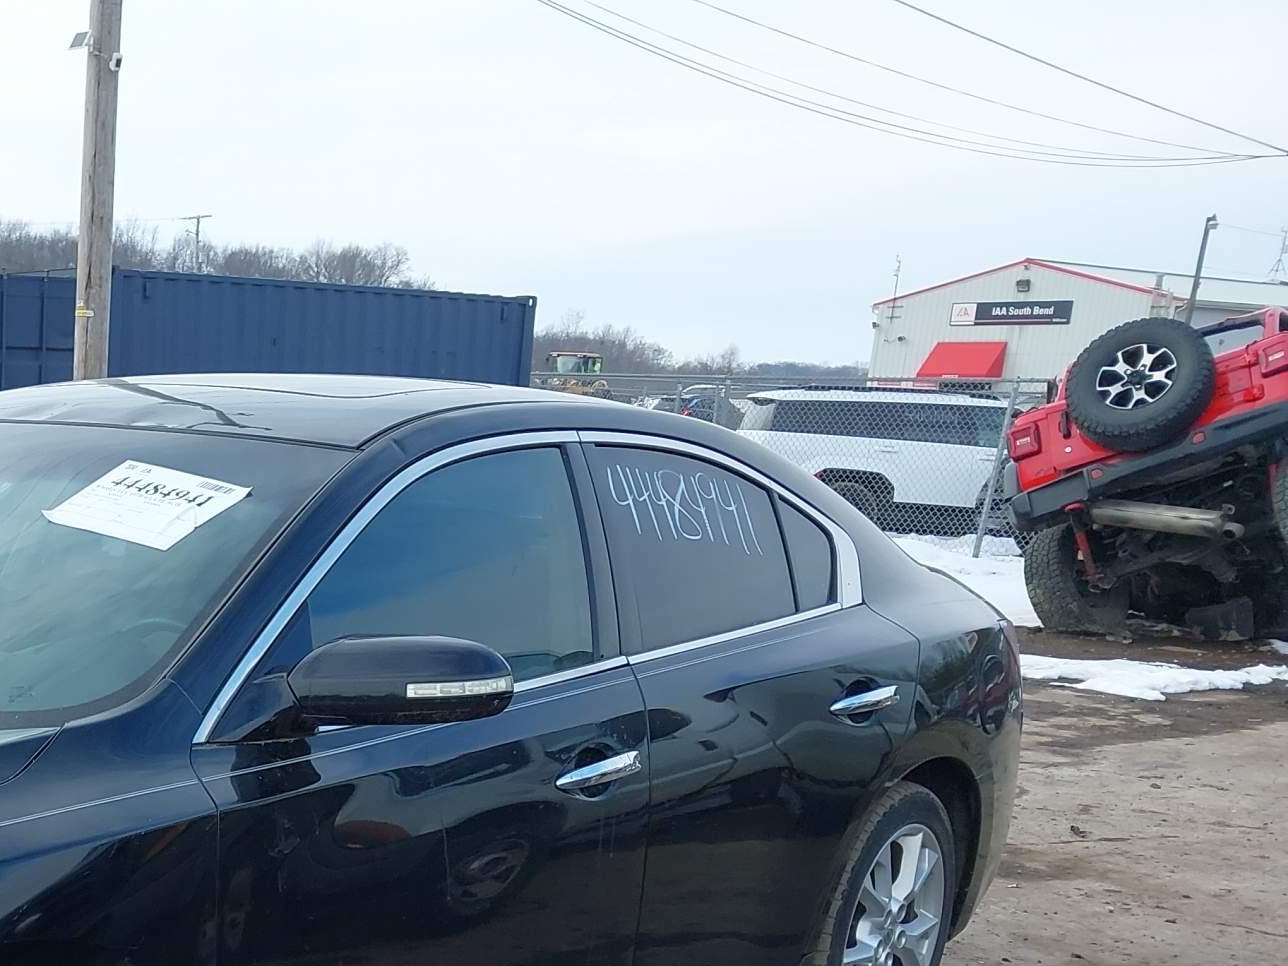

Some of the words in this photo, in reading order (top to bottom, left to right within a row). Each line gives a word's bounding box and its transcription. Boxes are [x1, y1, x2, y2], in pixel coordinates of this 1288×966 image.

[992, 306, 1007, 316] IAA
[1008, 306, 1032, 316] South
[1033, 305, 1054, 315] Bend
[111, 475, 215, 507] 44484941
[607, 464, 763, 556] 44484941
